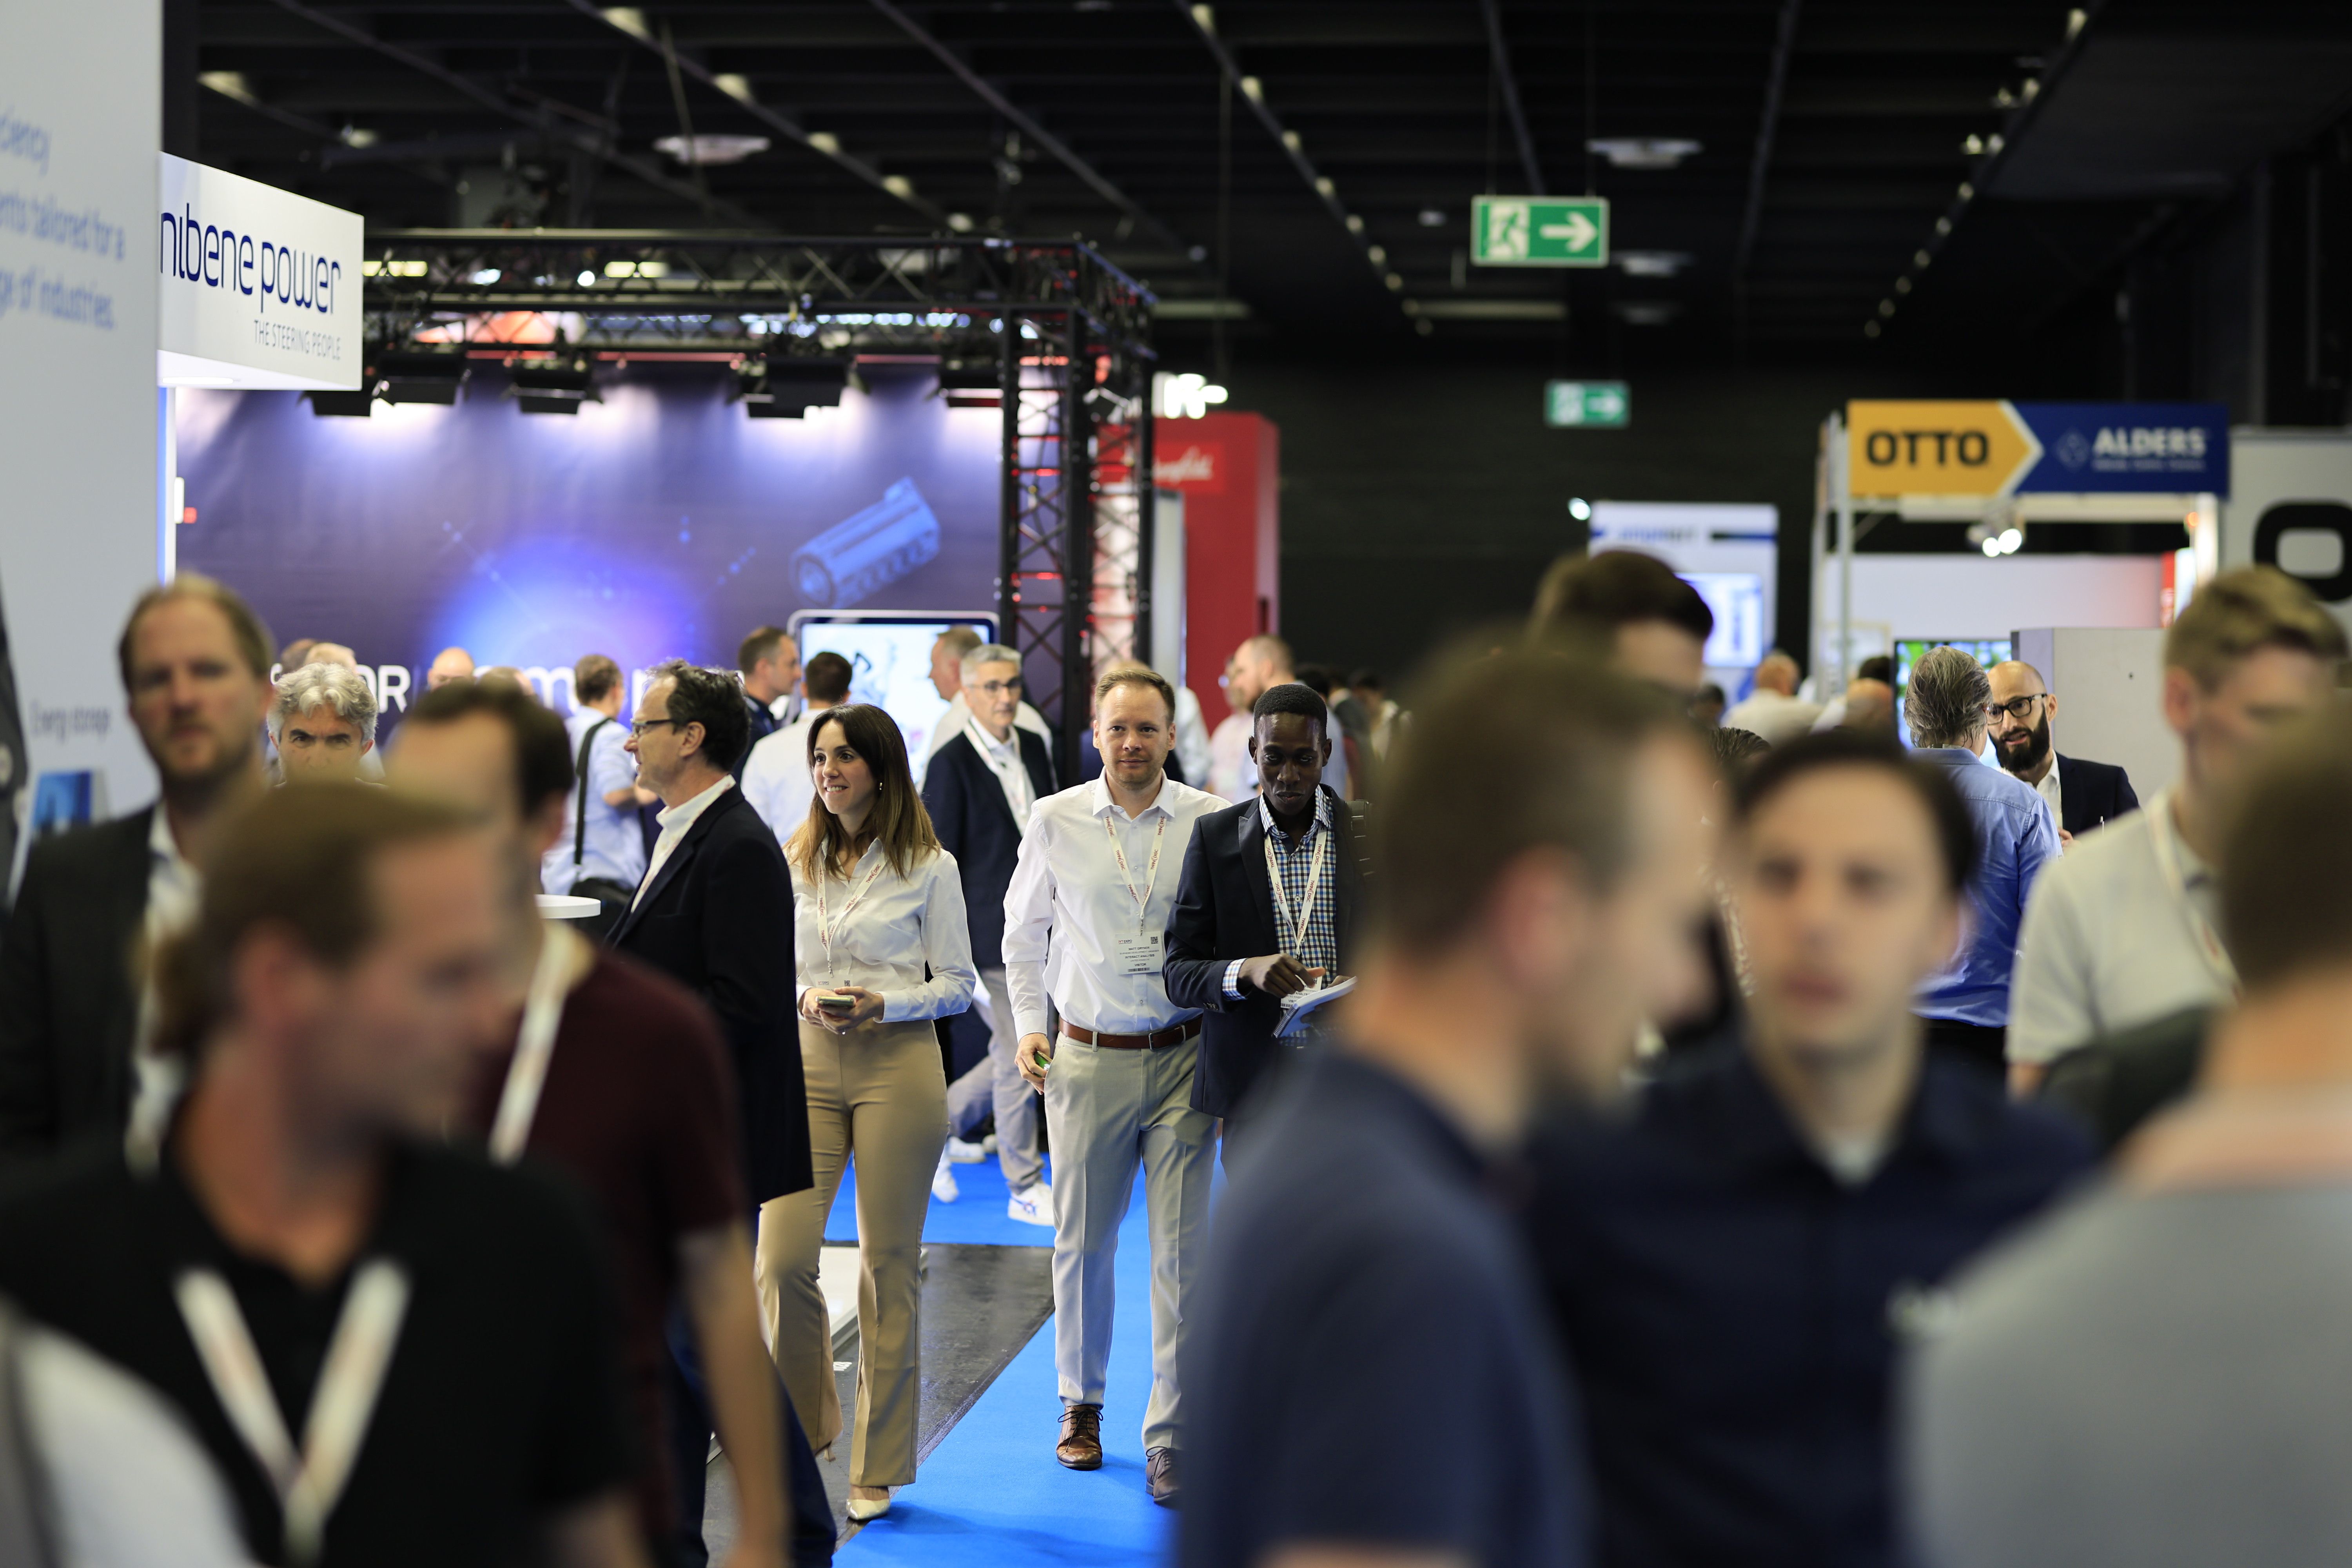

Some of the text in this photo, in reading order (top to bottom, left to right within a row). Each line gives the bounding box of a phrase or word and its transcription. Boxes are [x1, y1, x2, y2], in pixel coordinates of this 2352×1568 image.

[261, 241, 341, 314] power
[254, 319, 341, 361] THE STEERING PEOPLE
[1867, 430, 1989, 466] OTTO
